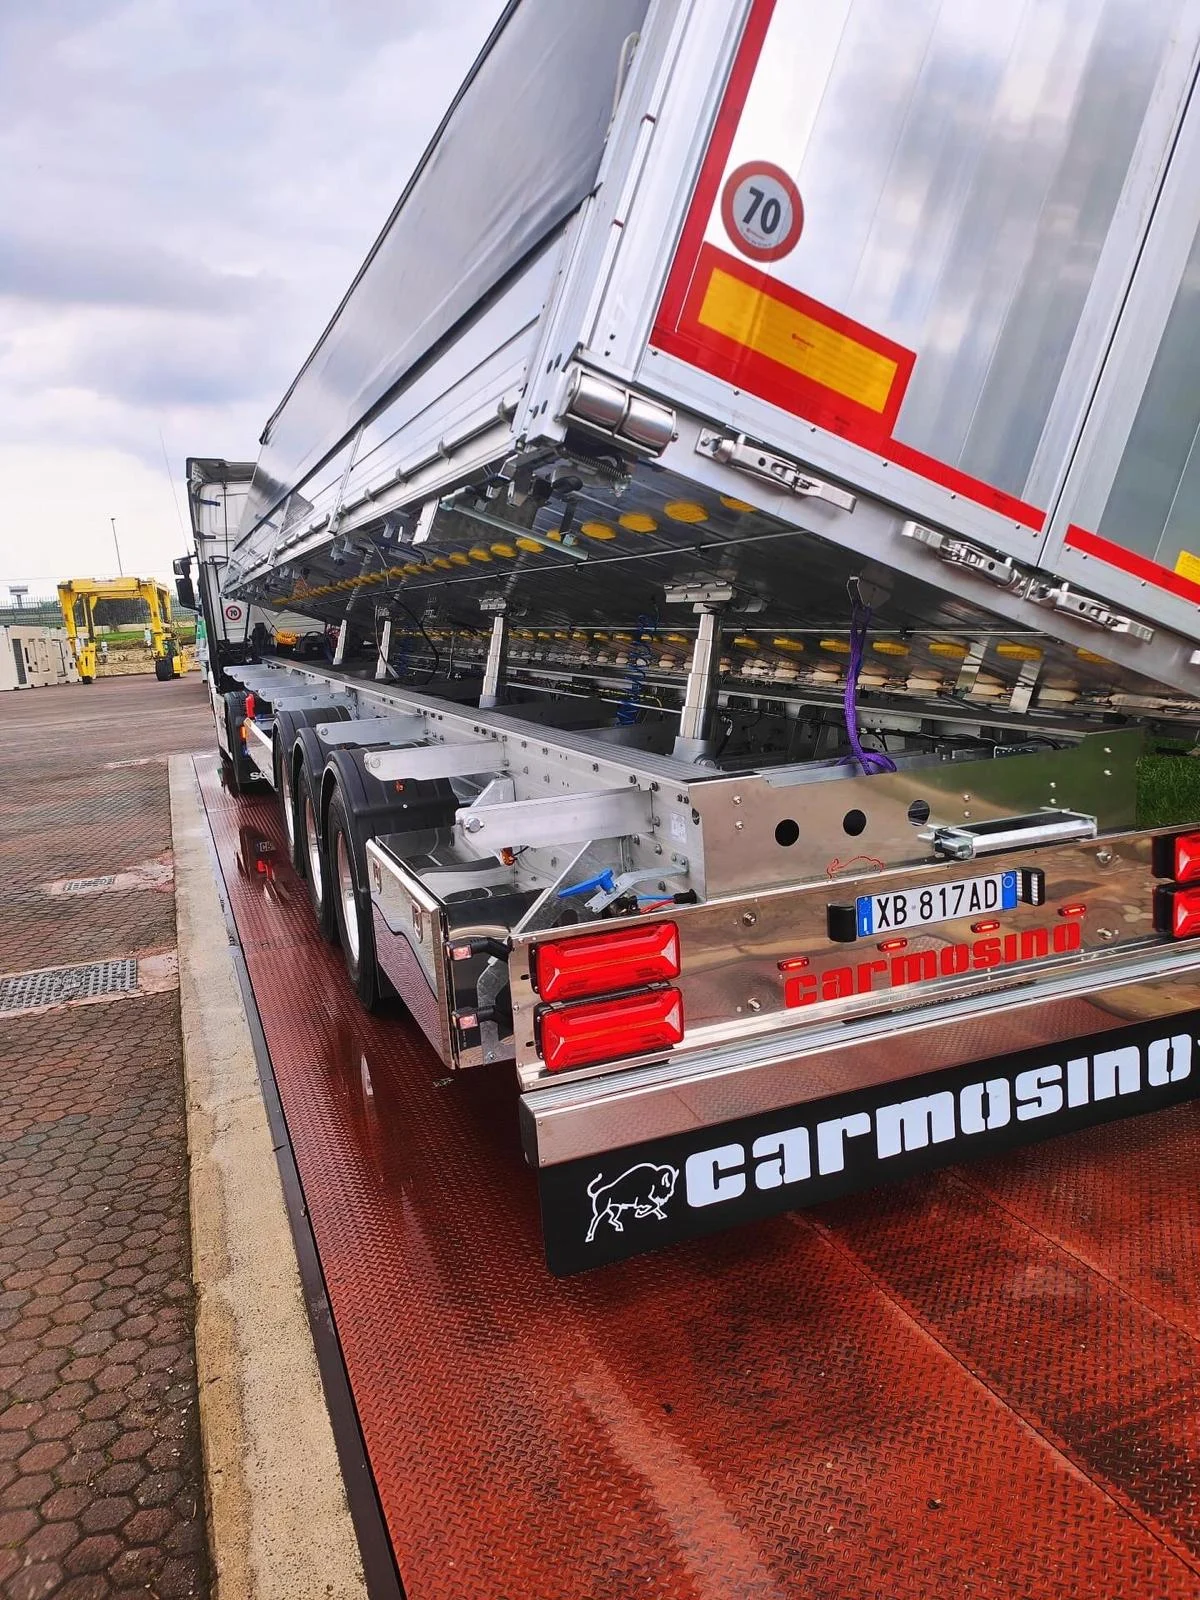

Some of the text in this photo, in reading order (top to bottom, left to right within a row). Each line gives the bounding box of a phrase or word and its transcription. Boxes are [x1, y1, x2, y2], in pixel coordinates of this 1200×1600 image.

[743, 186, 782, 235] 70
[876, 879, 998, 929] XB 817AD
[784, 921, 1081, 1009] carmosino
[686, 1033, 1192, 1208] carmosino
